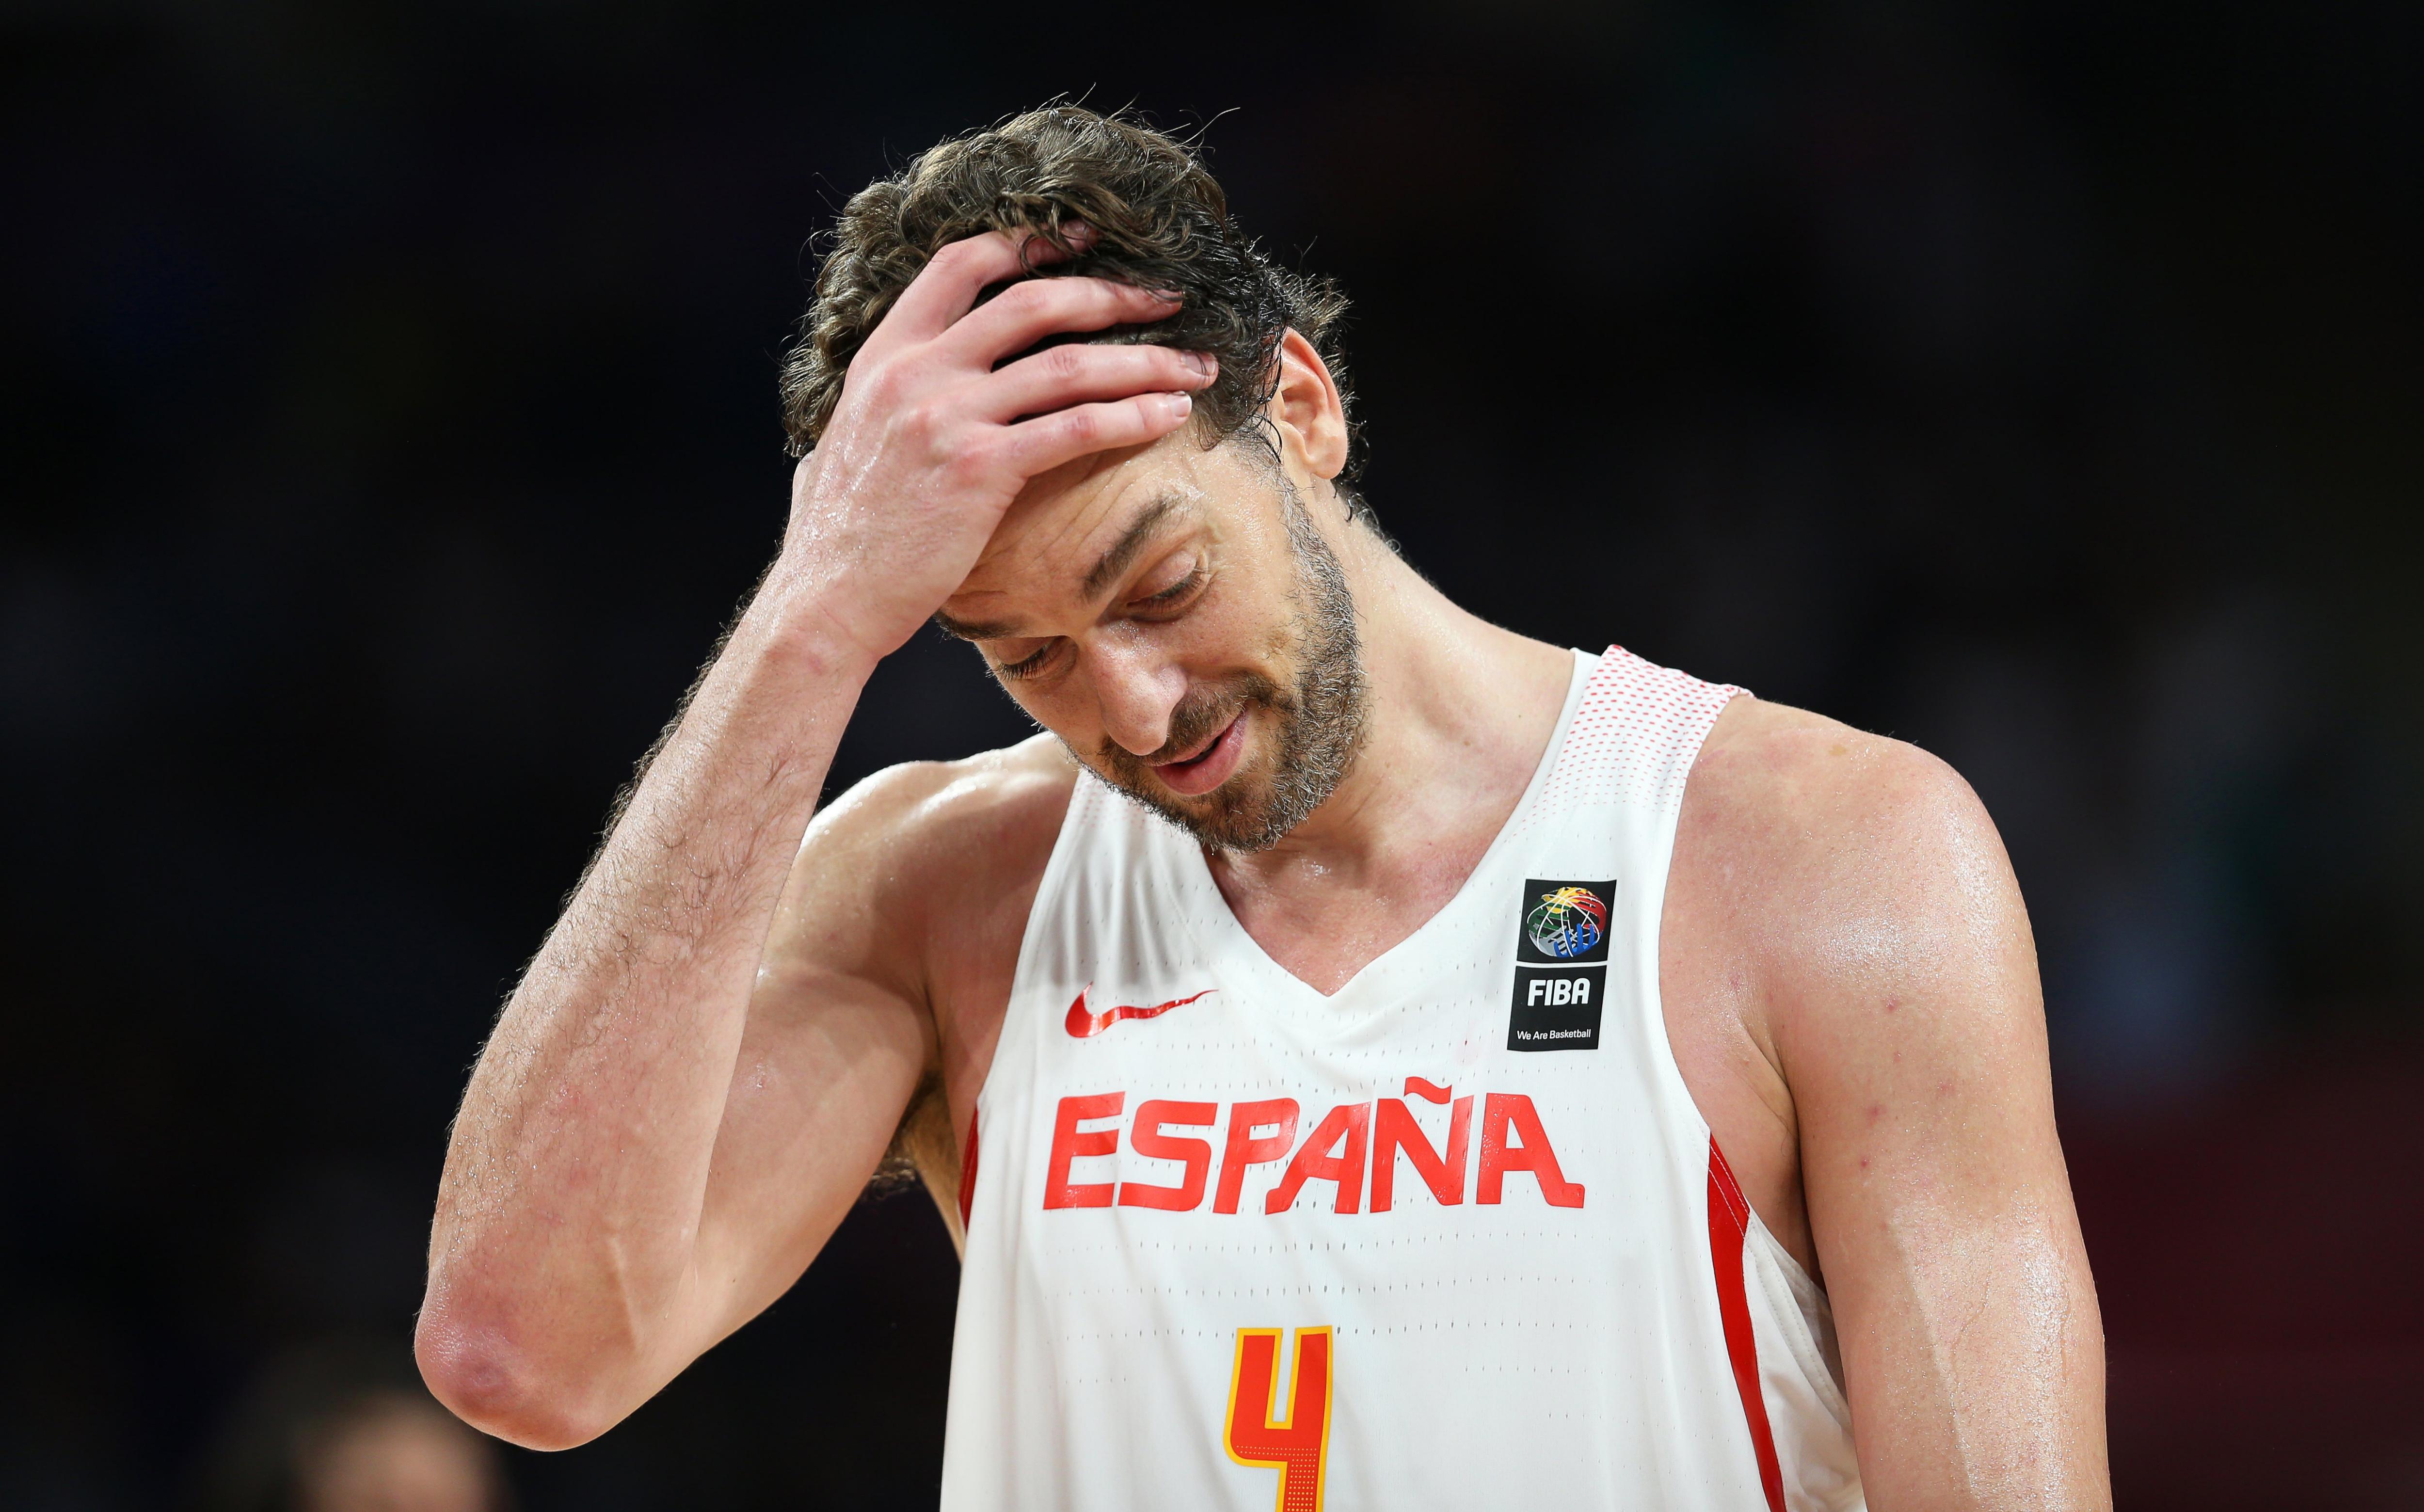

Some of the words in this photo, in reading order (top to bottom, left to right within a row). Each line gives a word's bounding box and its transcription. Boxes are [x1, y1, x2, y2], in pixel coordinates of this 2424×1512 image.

[1527, 978, 1591, 1006] FIBA
[1516, 1030, 1531, 1040] We
[1533, 1031, 1548, 1040] Are
[1549, 1029, 1591, 1039] Basketball
[1042, 1077, 1585, 1215] ESPAÑA
[1223, 1325, 1333, 1512] 4
